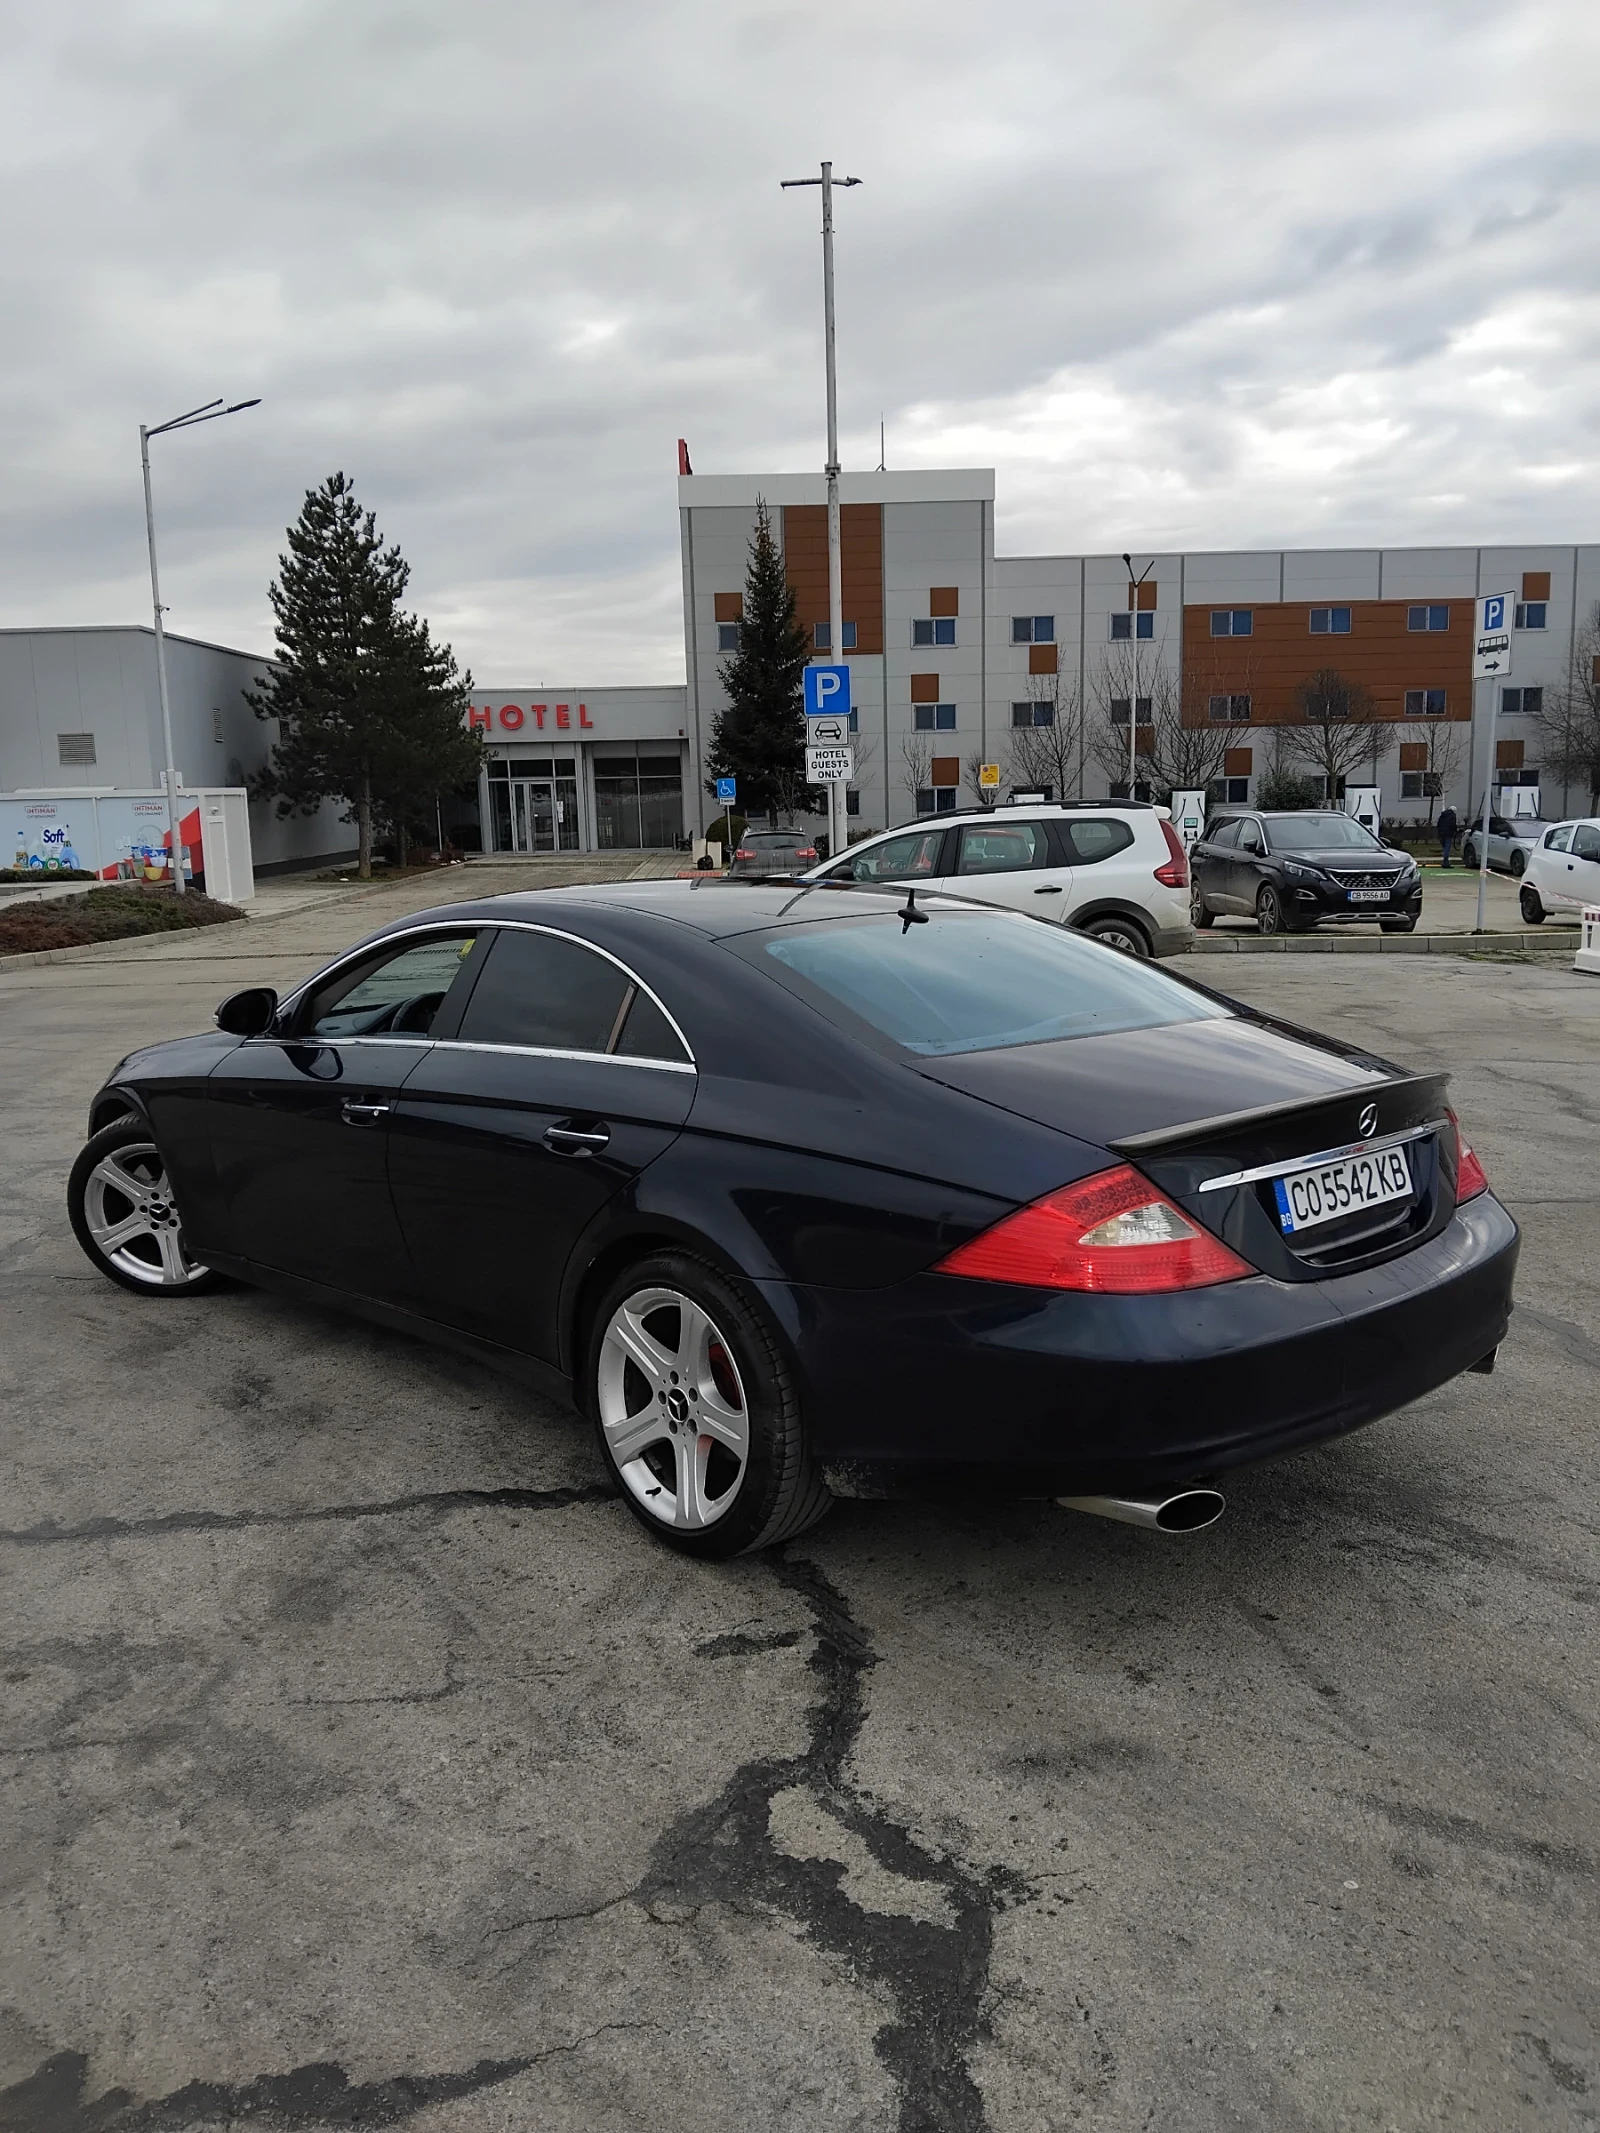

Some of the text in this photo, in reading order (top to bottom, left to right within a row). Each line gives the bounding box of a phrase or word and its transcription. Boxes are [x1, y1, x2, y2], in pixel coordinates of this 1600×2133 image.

[1488, 601, 1501, 628] P
[816, 672, 841, 708] P
[469, 704, 593, 730] HOTEL
[815, 750, 847, 759] HOTEL
[811, 760, 849, 769] GUESTS
[818, 770, 843, 779] ONLY
[43, 828, 65, 843] Soft
[1280, 1213, 1292, 1226] BG
